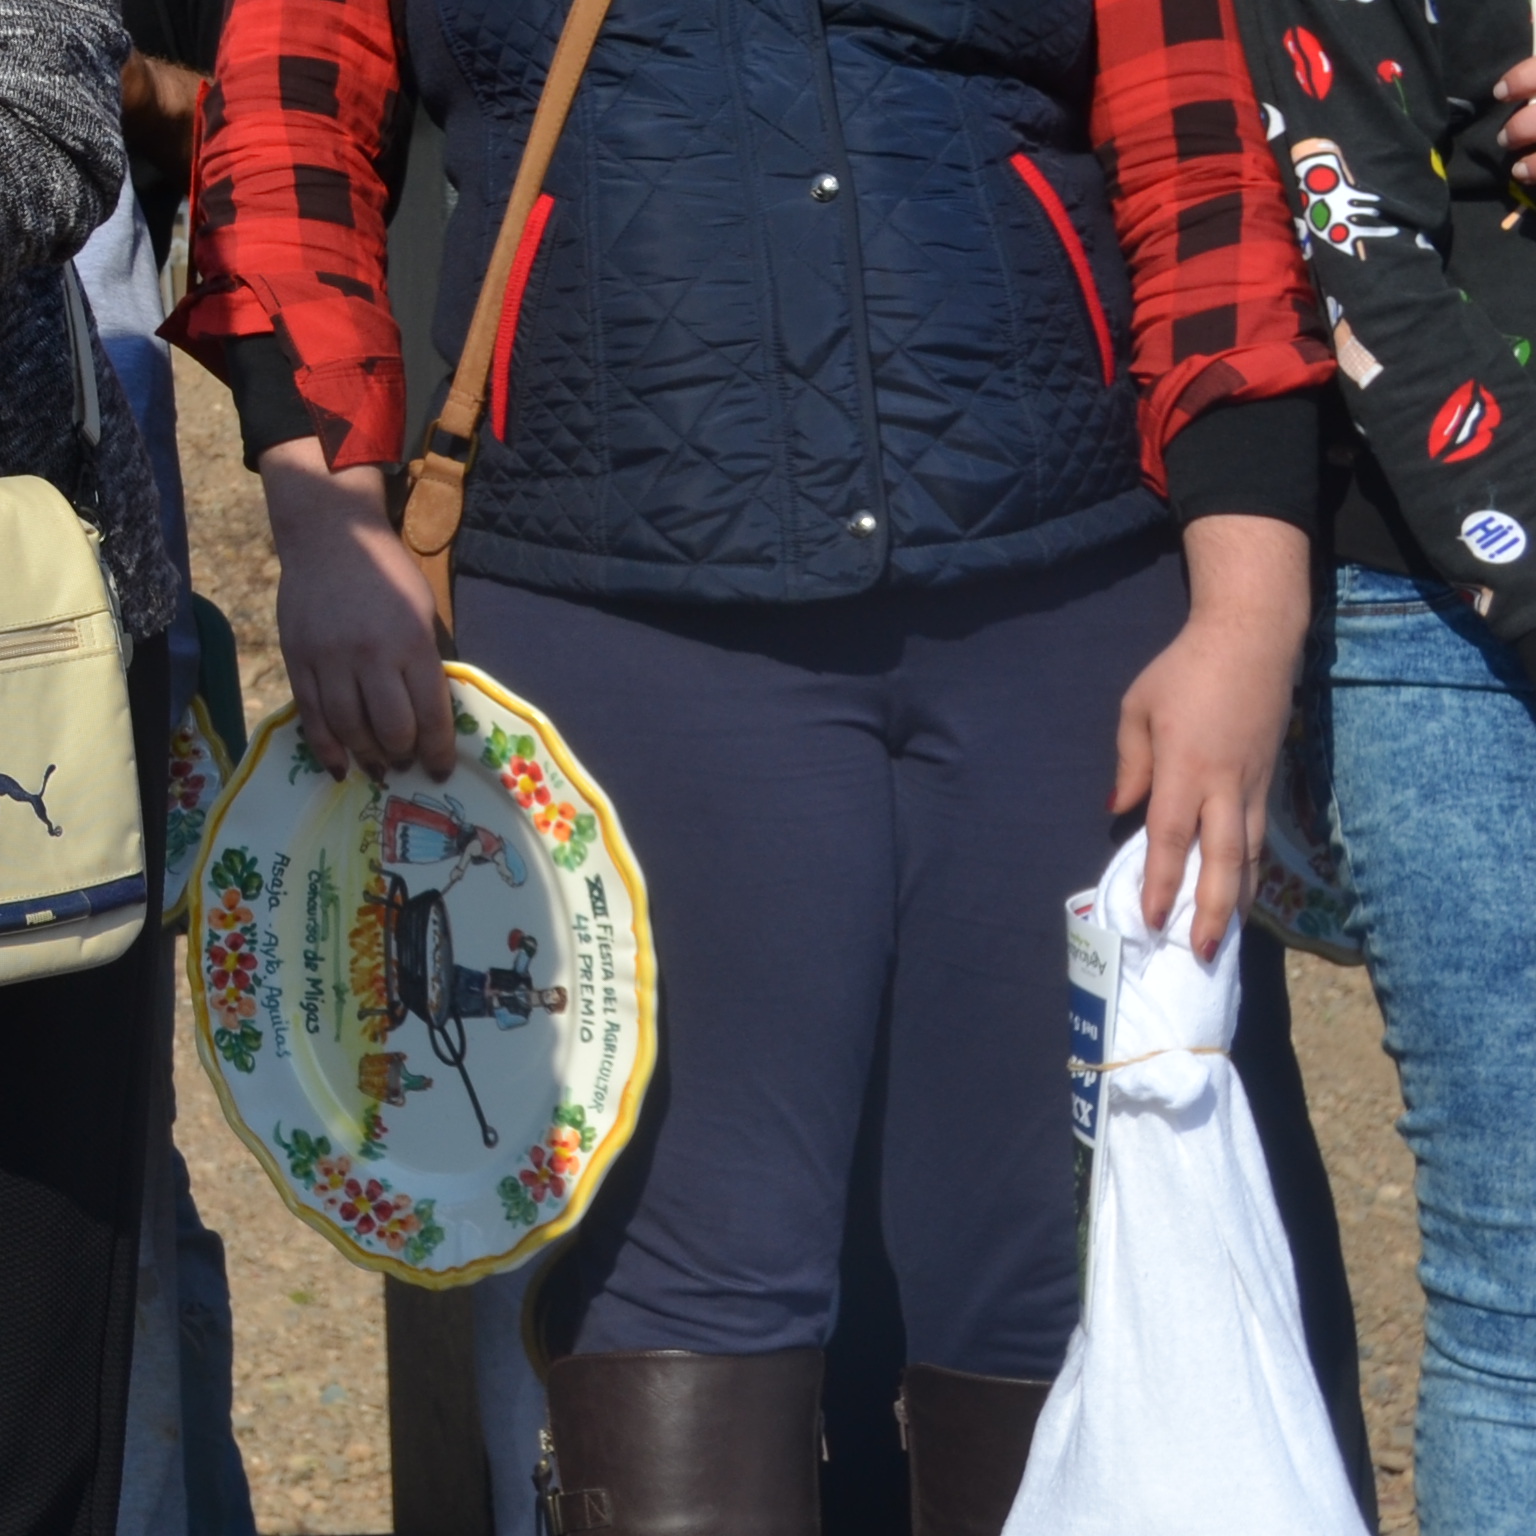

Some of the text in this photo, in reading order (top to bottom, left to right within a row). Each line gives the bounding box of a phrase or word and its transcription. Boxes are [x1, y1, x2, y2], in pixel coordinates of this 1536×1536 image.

[1464, 516, 1521, 560] Hi!
[265, 850, 291, 913] Asaja
[303, 948, 325, 973] de
[299, 976, 326, 1036] Migas
[578, 953, 596, 1044] PREMIO
